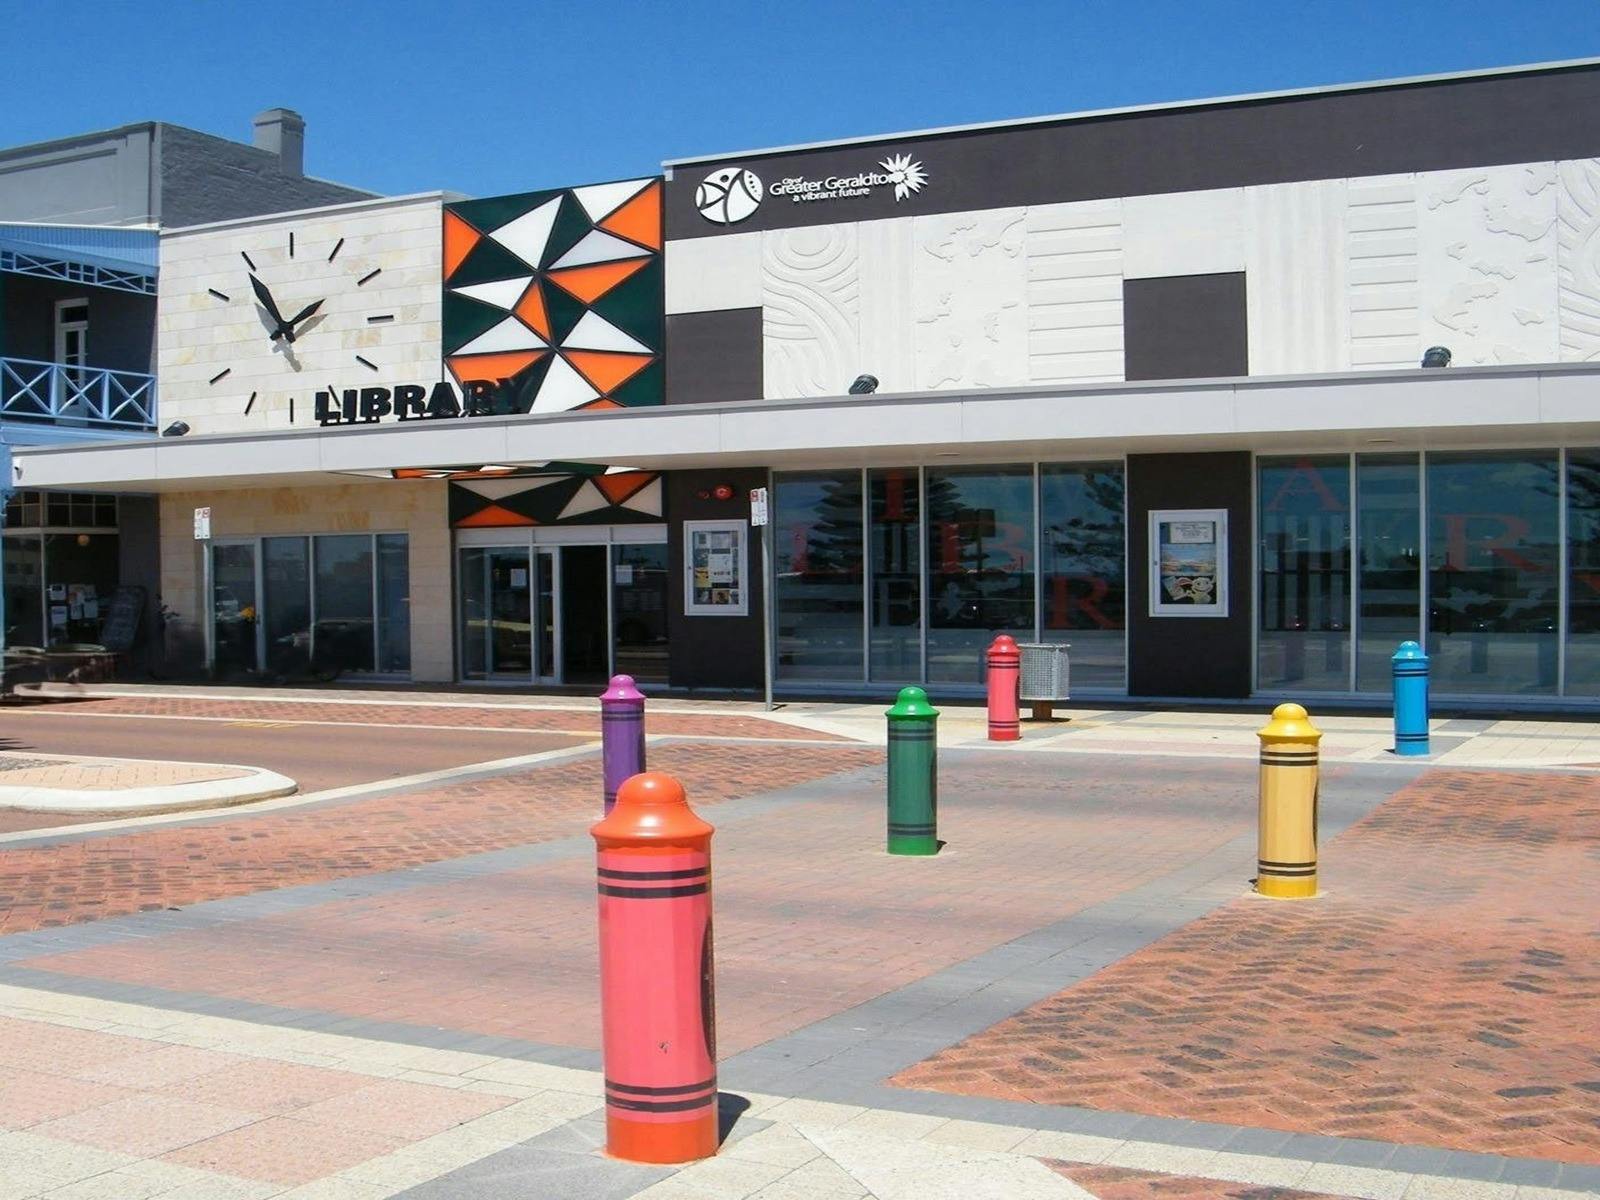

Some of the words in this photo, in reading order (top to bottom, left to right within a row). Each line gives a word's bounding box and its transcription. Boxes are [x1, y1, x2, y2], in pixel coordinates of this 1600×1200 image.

[769, 178, 822, 195] Greater
[801, 189, 837, 202] vibrant
[838, 186, 870, 198] future
